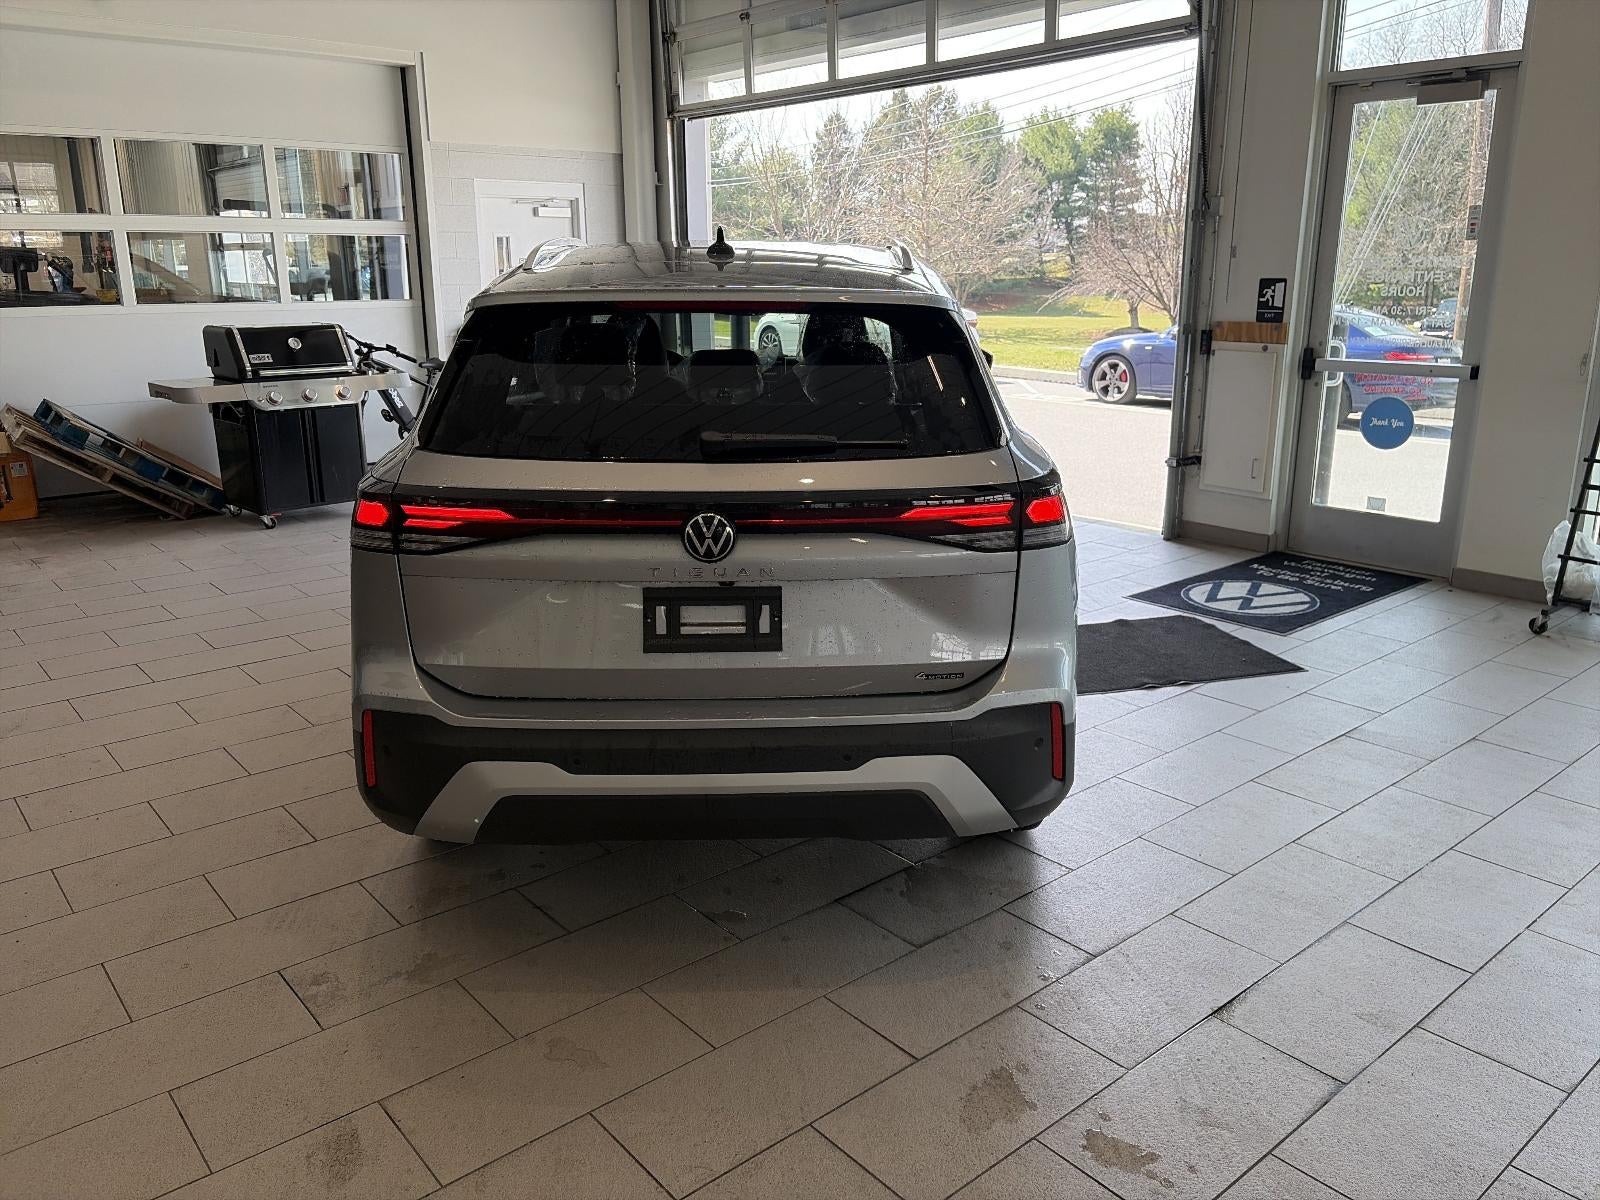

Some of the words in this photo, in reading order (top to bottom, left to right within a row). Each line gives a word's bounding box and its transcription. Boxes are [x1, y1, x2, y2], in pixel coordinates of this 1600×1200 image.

[1369, 417, 1389, 427] Thank
[1391, 418, 1405, 429] You
[647, 566, 777, 578] TIGUAN
[914, 671, 965, 680] 4MOTION
